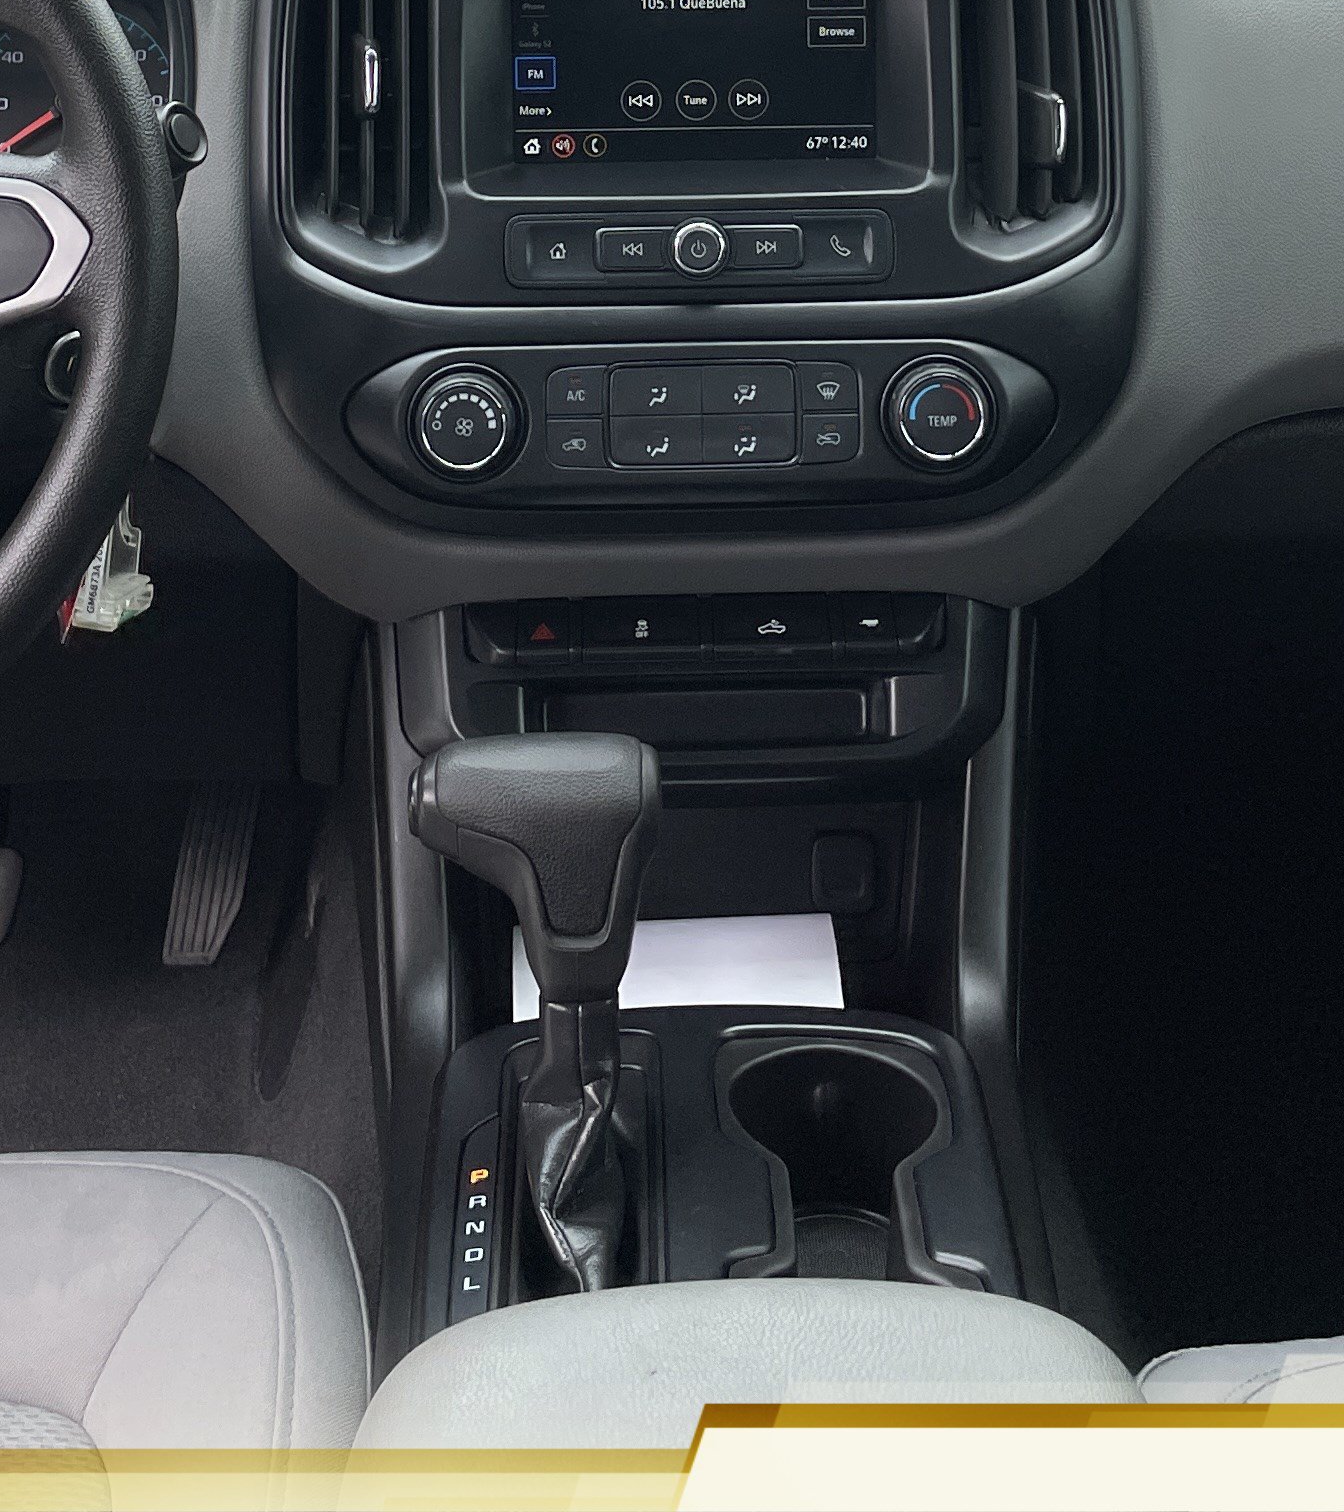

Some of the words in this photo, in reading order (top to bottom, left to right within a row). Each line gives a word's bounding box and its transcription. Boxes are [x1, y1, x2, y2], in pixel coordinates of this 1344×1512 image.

[818, 26, 856, 38] Browse
[1, 51, 24, 64] 40
[527, 69, 544, 81] FM
[683, 95, 708, 106] Tune
[519, 105, 546, 117] More
[831, 136, 868, 149] 12:40
[566, 388, 587, 404] A/C
[926, 413, 959, 430] TEMP
[471, 1169, 489, 1184] P
[469, 1195, 487, 1209] R
[466, 1221, 485, 1235] N
[463, 1276, 481, 1291] L
